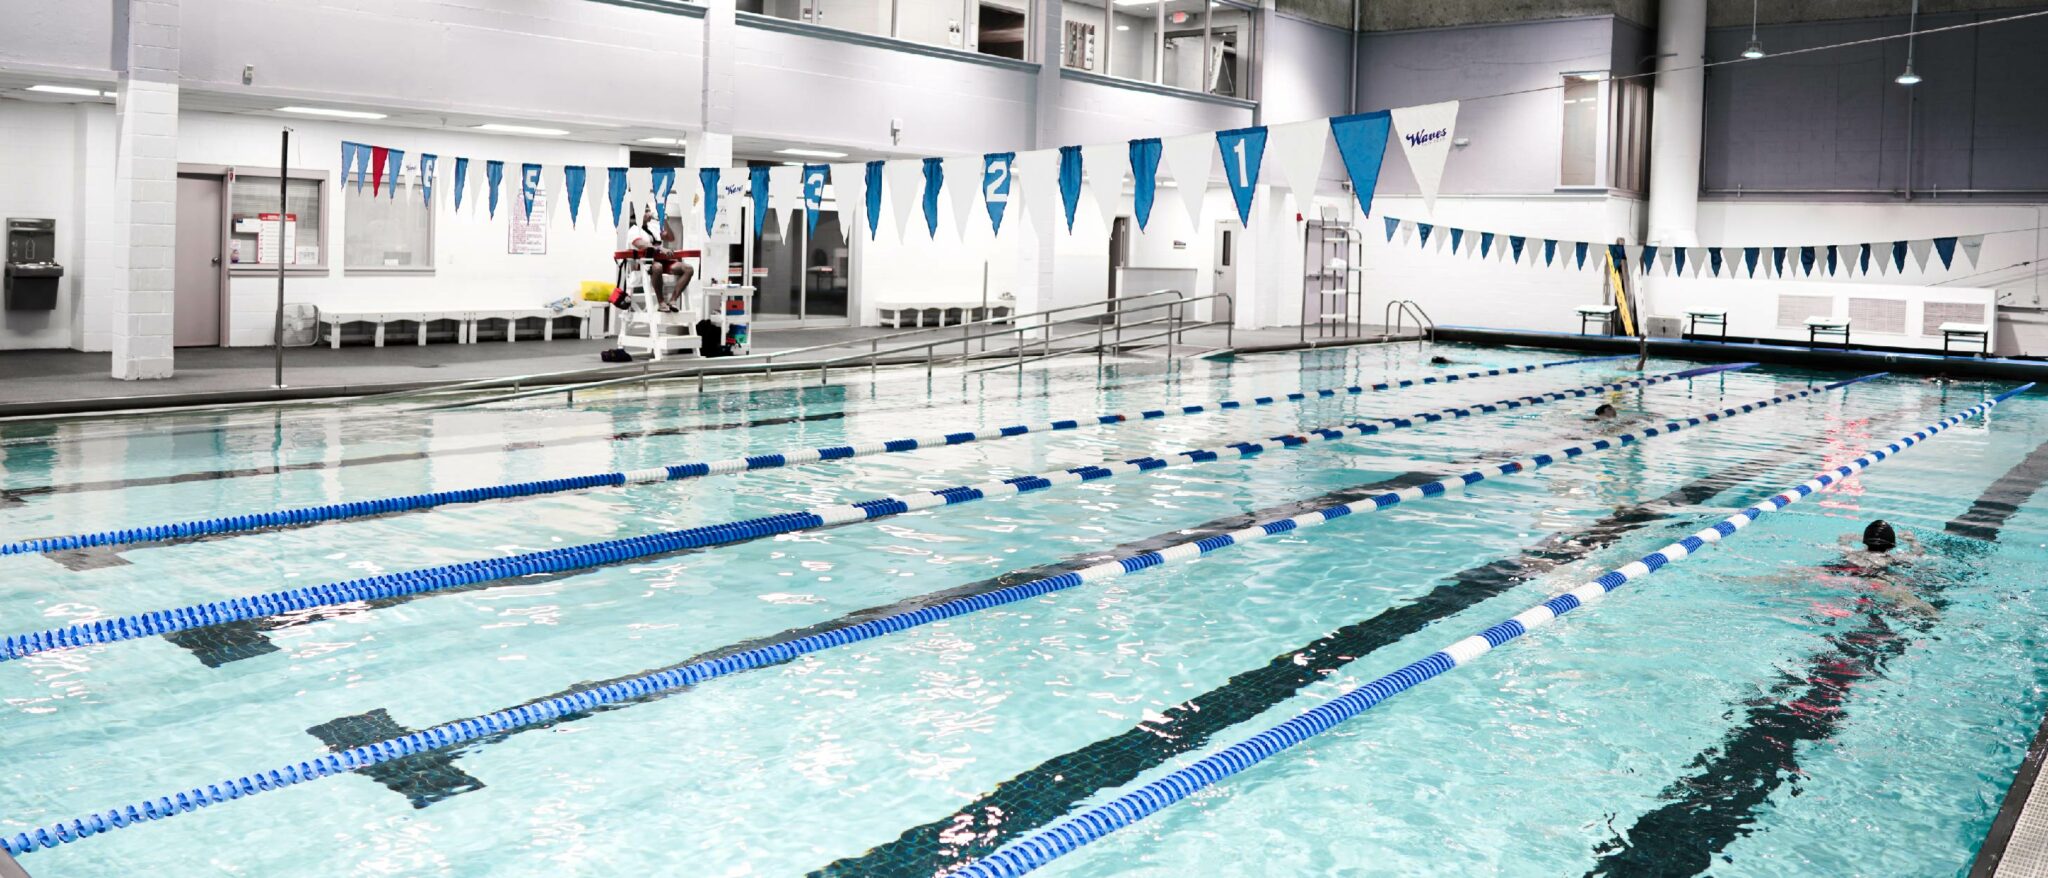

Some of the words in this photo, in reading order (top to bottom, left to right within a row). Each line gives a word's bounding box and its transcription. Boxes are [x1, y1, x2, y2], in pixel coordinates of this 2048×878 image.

[1405, 127, 1448, 148] Waves
[1233, 138, 1249, 188] 1
[525, 169, 538, 201] 5
[655, 174, 668, 204] 4
[805, 172, 825, 210] 3
[986, 160, 1008, 203] 2
